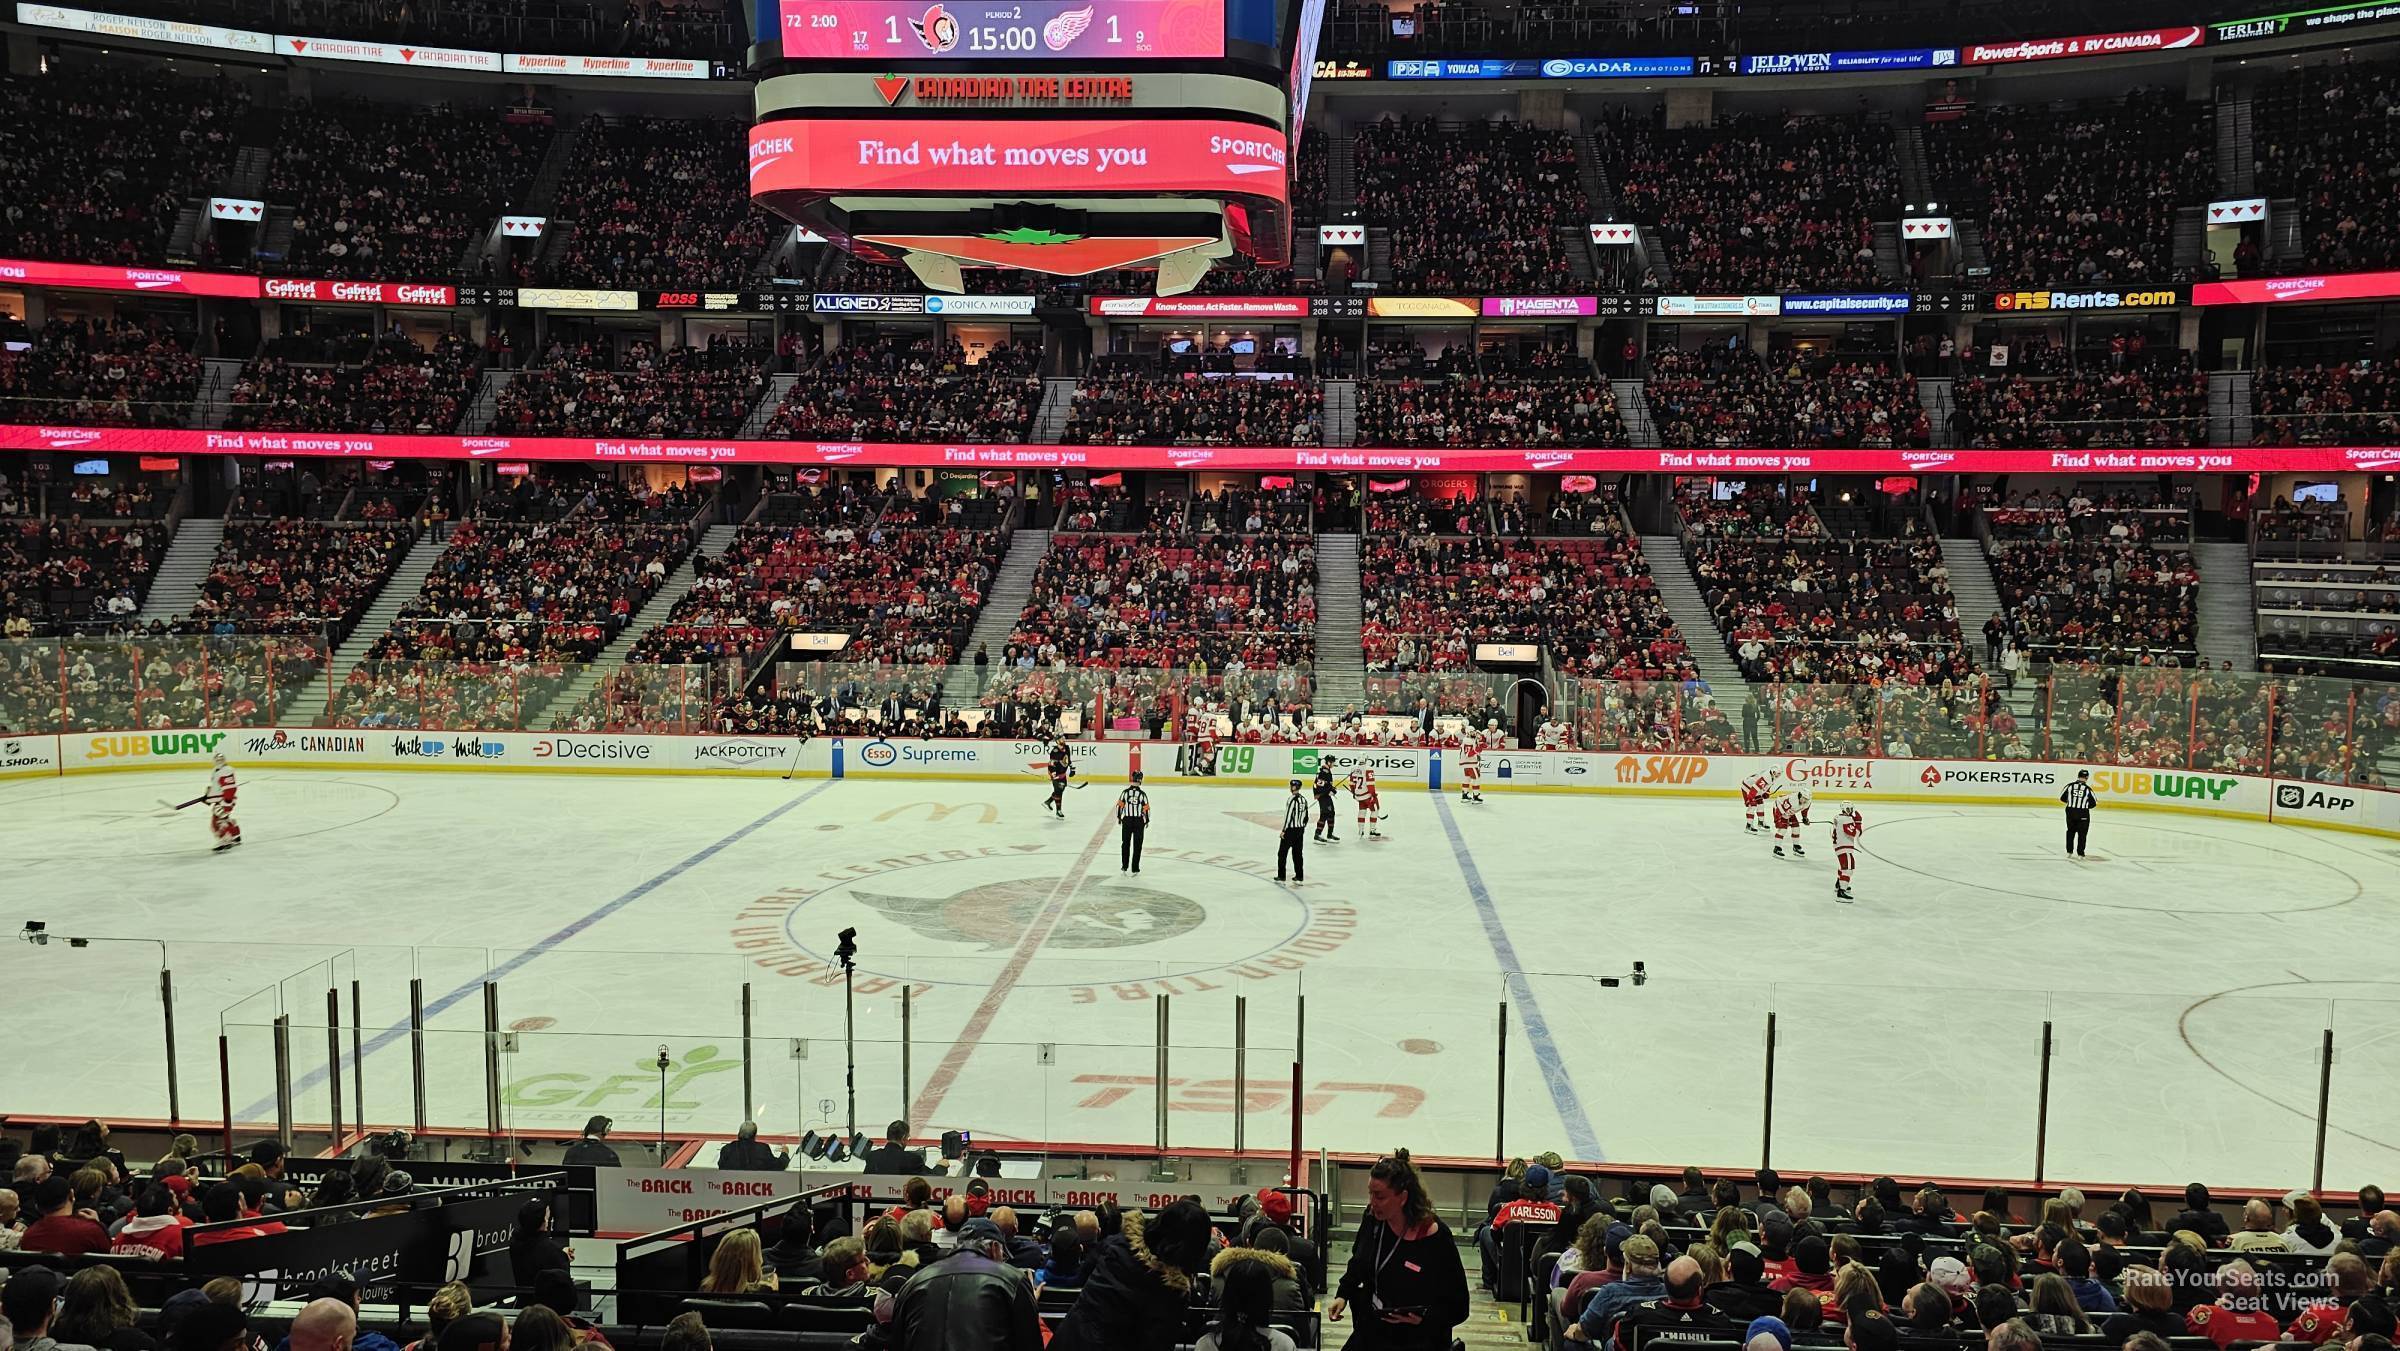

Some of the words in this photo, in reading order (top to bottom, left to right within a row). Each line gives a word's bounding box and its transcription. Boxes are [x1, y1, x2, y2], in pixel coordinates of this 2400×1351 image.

[1013, 7, 1021, 19] 2
[2306, 17, 2321, 26] we
[2323, 13, 2355, 25] shape
[2356, 10, 2374, 19] the
[93, 13, 123, 25] ROGER
[127, 16, 166, 30] NEILSON
[786, 15, 801, 28] 72
[811, 14, 838, 28] 2:00
[100, 25, 139, 35] MAISON
[141, 29, 171, 40] ROGER
[174, 32, 212, 45] NEILSON
[885, 16, 901, 43] 1
[1107, 15, 1122, 43] 1
[2217, 20, 2274, 37] TERLIN
[853, 31, 867, 44] 17
[969, 27, 1037, 50] 15:00
[1136, 31, 1144, 43] 9
[311, 43, 360, 56] CANADIAN
[363, 47, 383, 56] TIRE
[1973, 42, 2063, 61] PowerSports
[2068, 41, 2078, 53] &
[2084, 39, 2103, 51] RV
[2103, 34, 2161, 49] CANADA
[419, 51, 466, 63] CANADIAN
[469, 55, 489, 65] TIRE
[519, 56, 566, 68] Hyperline
[583, 57, 630, 69] Hyperline
[646, 58, 693, 71] Hyperline
[1838, 57, 1879, 65] RELIABILITY
[1881, 56, 1892, 64] for
[1448, 65, 1480, 74] YOW.CA
[1573, 62, 1632, 73] GADAR
[914, 77, 1013, 99] CANADIAN
[1017, 77, 1059, 99] TIRE
[1063, 77, 1133, 99] CENTRE
[858, 140, 921, 166] Find
[927, 141, 997, 166] what
[1003, 147, 1090, 166] moves
[1095, 147, 1148, 173] you
[126, 269, 181, 283] SPORTCHEK
[266, 280, 316, 295] Gabriel
[332, 283, 382, 298] Gabriel
[2265, 279, 2325, 290] SPORTCHEK
[397, 286, 446, 301] Gabriel
[658, 293, 697, 304] ROSS
[815, 297, 878, 309] ALIGNED
[947, 301, 987, 310] KONICA
[989, 301, 1034, 310] MINOLTA
[1155, 303, 1177, 311] Know
[1206, 303, 1218, 311] Act
[1243, 303, 1274, 311] Remove
[1516, 299, 1579, 310] MAGENTA
[1785, 298, 1909, 310] www.capitalsecurity.ca
[40, 428, 100, 438] SPORTCHEK
[206, 433, 243, 448] Find
[249, 436, 287, 449] what
[292, 439, 341, 450] moves
[344, 439, 374, 454] you
[462, 438, 510, 448] SPORTCHEK
[816, 444, 863, 453] SPORTCHEK
[595, 442, 624, 456] Find
[629, 443, 663, 456] what
[667, 446, 708, 456] moves
[711, 446, 736, 460] you
[944, 448, 976, 461] Find
[980, 449, 1013, 461] what
[1017, 451, 1058, 462] moves
[1061, 452, 1086, 465] you
[1524, 451, 1573, 461] SPORTCHEK
[1902, 452, 1954, 461] SPORTCHEK
[1296, 453, 1327, 465] Find
[1331, 453, 1365, 465] what
[1368, 456, 1411, 466] moves
[1415, 456, 1441, 469] you
[1660, 454, 1692, 466] Find
[1696, 454, 1731, 466] what
[1735, 456, 1781, 466] moves
[1784, 457, 1811, 470] you
[2051, 453, 2090, 467] Find
[2094, 453, 2135, 467] what
[2140, 455, 2196, 467] moves
[2198, 454, 2233, 471] you
[1431, 479, 1468, 488] ROGERS
[812, 636, 829, 645] Bell
[1499, 647, 1514, 656] Bell
[85, 732, 226, 760] SUBWAY
[245, 733, 296, 752] Molson
[301, 736, 365, 752] CANADIAN
[557, 739, 650, 759] Decisive
[695, 746, 786, 758] JACKPOTCITY
[867, 748, 892, 759] Esso
[903, 745, 976, 764] Supreme
[1641, 757, 1709, 784] SKIP
[1786, 758, 1874, 782] Gabriel
[1945, 770, 2055, 784] POKERSTARS
[1812, 780, 1873, 789] PIZZA
[2094, 771, 2239, 800] SUBWAY
[2072, 788, 2083, 797] 59
[627, 1179, 640, 1190] The
[641, 1180, 693, 1194] BRICK
[708, 1181, 721, 1190] The
[722, 1182, 773, 1196] BRICK
[888, 1187, 901, 1197] The
[1052, 1191, 1065, 1201] The
[1067, 1191, 1117, 1206] BRICK
[1134, 1193, 1147, 1204] The
[1217, 1196, 1230, 1206] The
[667, 1209, 681, 1218] The
[1509, 1205, 1557, 1221] KARLSSON
